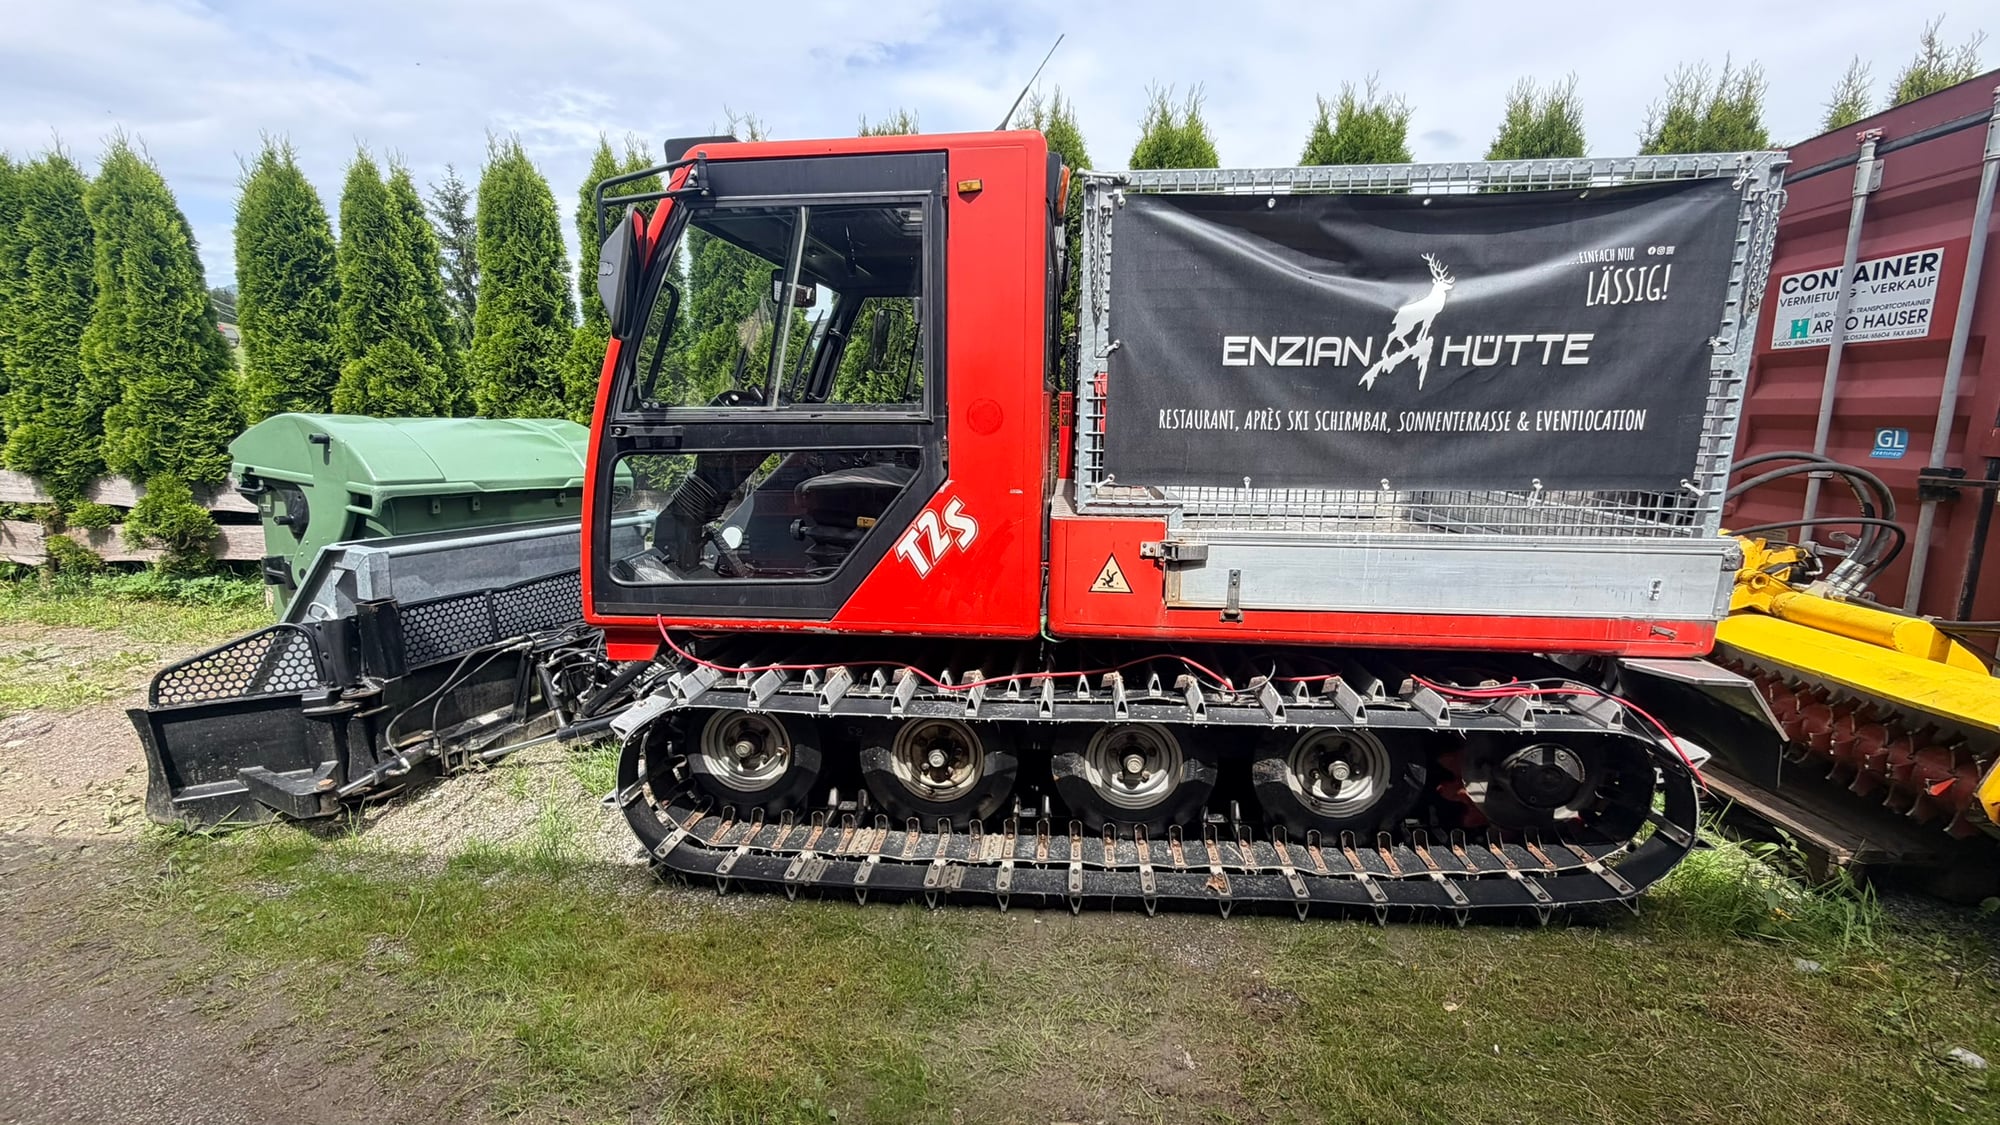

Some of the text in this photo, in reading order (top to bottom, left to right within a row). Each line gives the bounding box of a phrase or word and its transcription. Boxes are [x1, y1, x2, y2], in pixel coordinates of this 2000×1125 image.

[1617, 247, 1635, 261] NUR
[1585, 264, 1672, 307] LÄSSIG!
[1781, 252, 1939, 295] CONAINER
[1870, 276, 1935, 295] VERKAUF
[1812, 316, 1859, 335] ARO
[1863, 308, 1929, 329] HAUSER
[1222, 333, 1595, 367] ENZIAN HÜTTE
[1158, 407, 1647, 433] RESTAURANT, APRÈS SKI SCHIRMBAR, SONNENTERRASSE & EVENTLOCATION
[1877, 430, 1905, 448] GL
[893, 494, 979, 580] T2S
